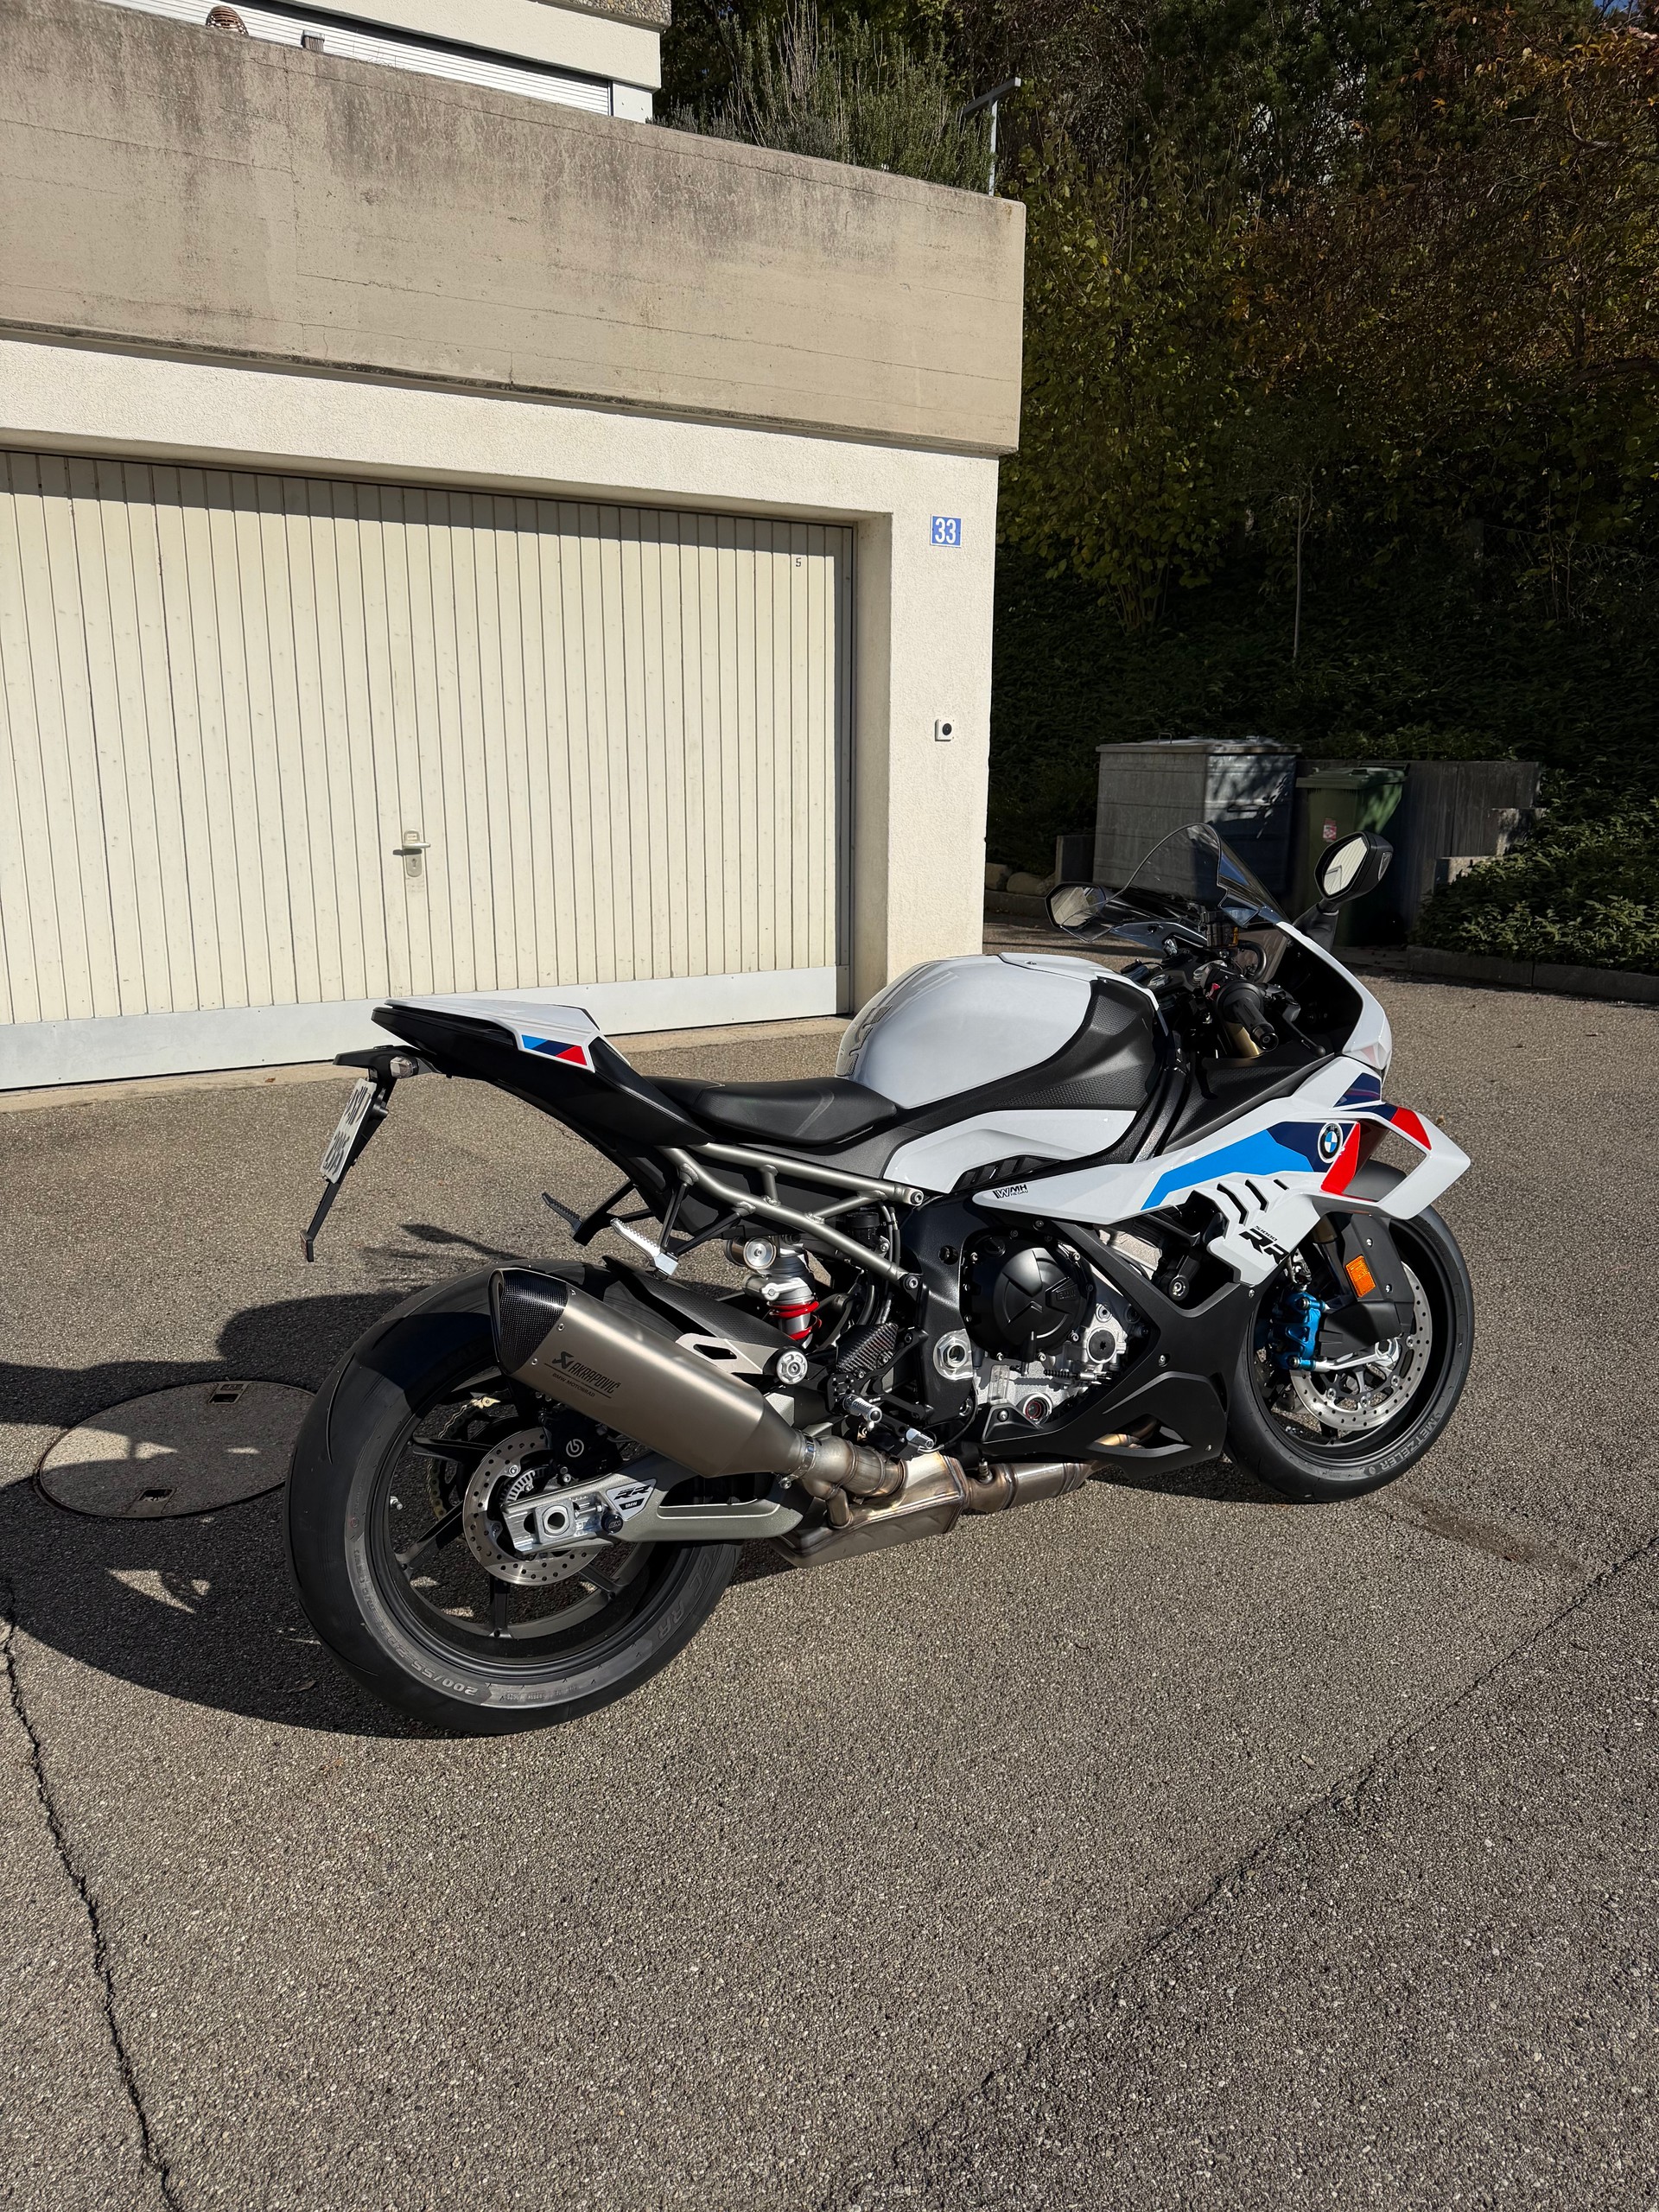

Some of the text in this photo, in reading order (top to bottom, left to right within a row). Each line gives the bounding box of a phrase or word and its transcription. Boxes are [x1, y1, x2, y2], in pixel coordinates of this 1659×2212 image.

[935, 518, 957, 543] 33
[795, 557, 802, 567] 5
[1238, 1228, 1290, 1264] RR
[1379, 1418, 1438, 1471] METZELER
[613, 1484, 652, 1500] RR
[410, 1659, 478, 1696] 200/55
